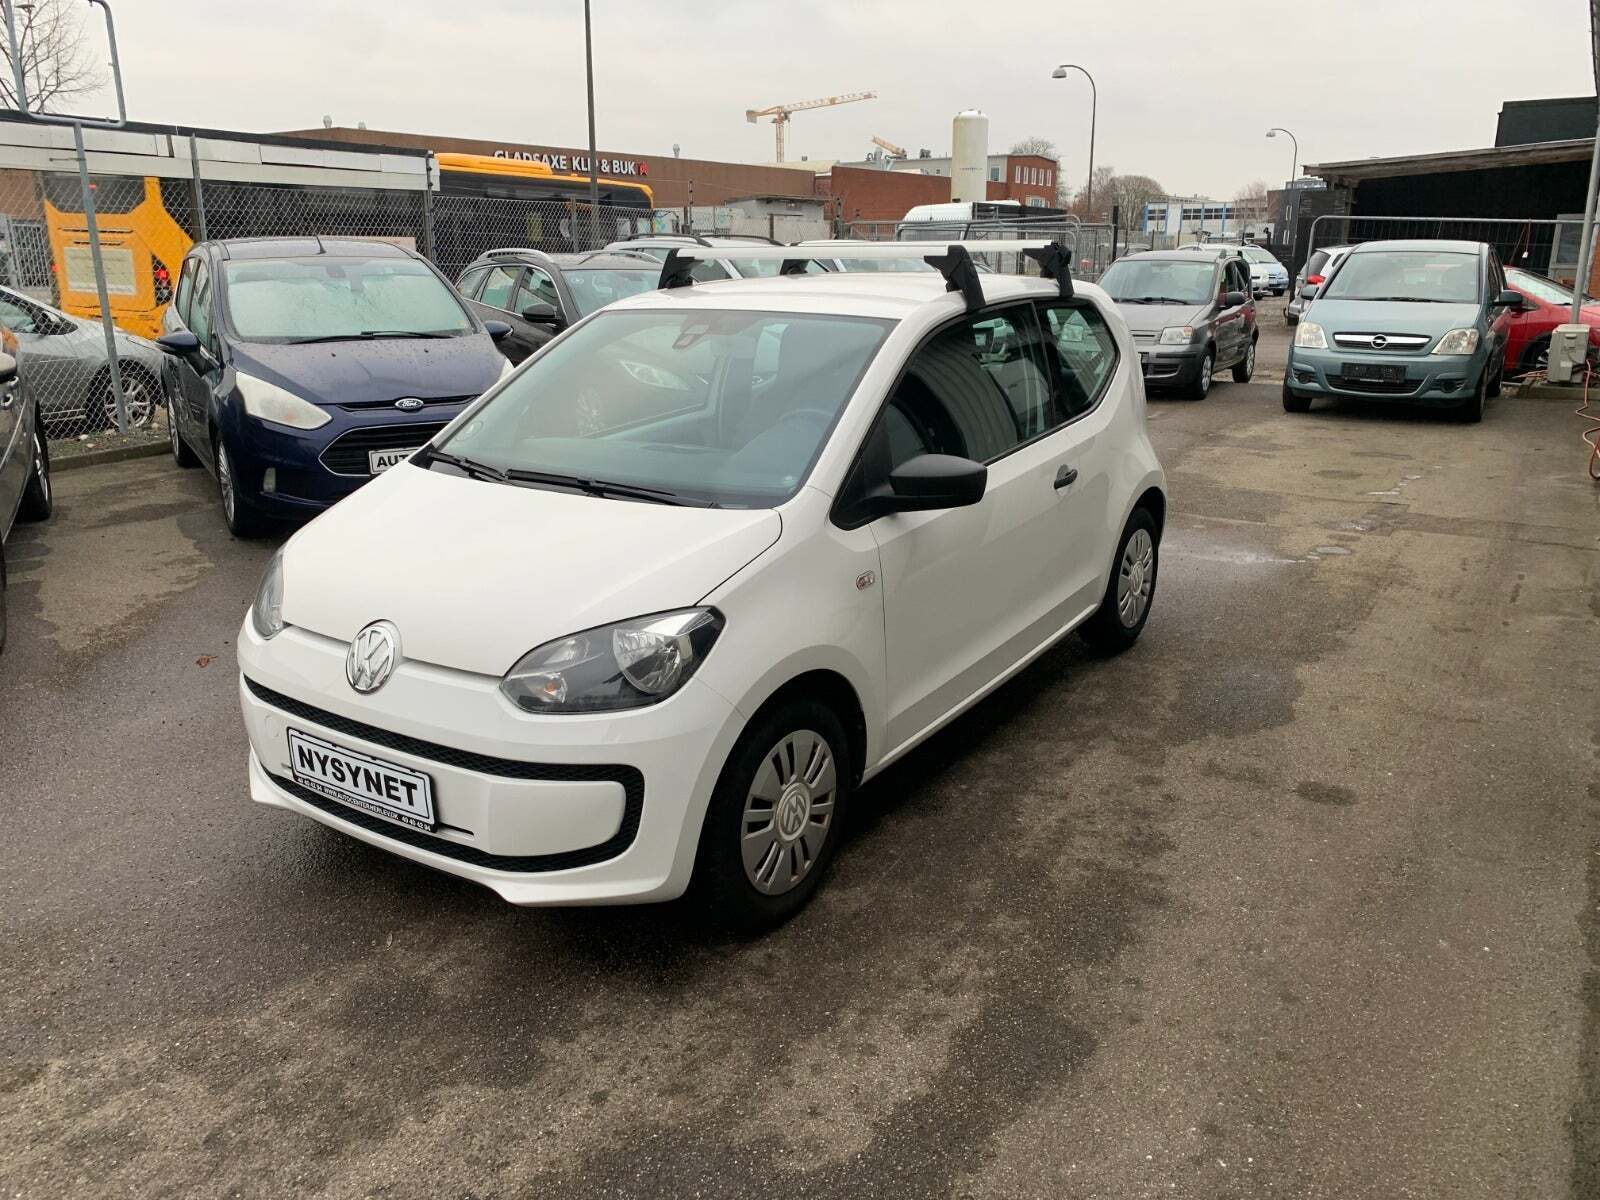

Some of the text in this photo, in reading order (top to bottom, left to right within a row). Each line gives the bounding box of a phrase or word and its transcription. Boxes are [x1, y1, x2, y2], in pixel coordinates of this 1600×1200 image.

[572, 156, 599, 172] KLI
[601, 159, 610, 172] &
[612, 159, 636, 175] BUK
[297, 744, 418, 807] NYSYNET
